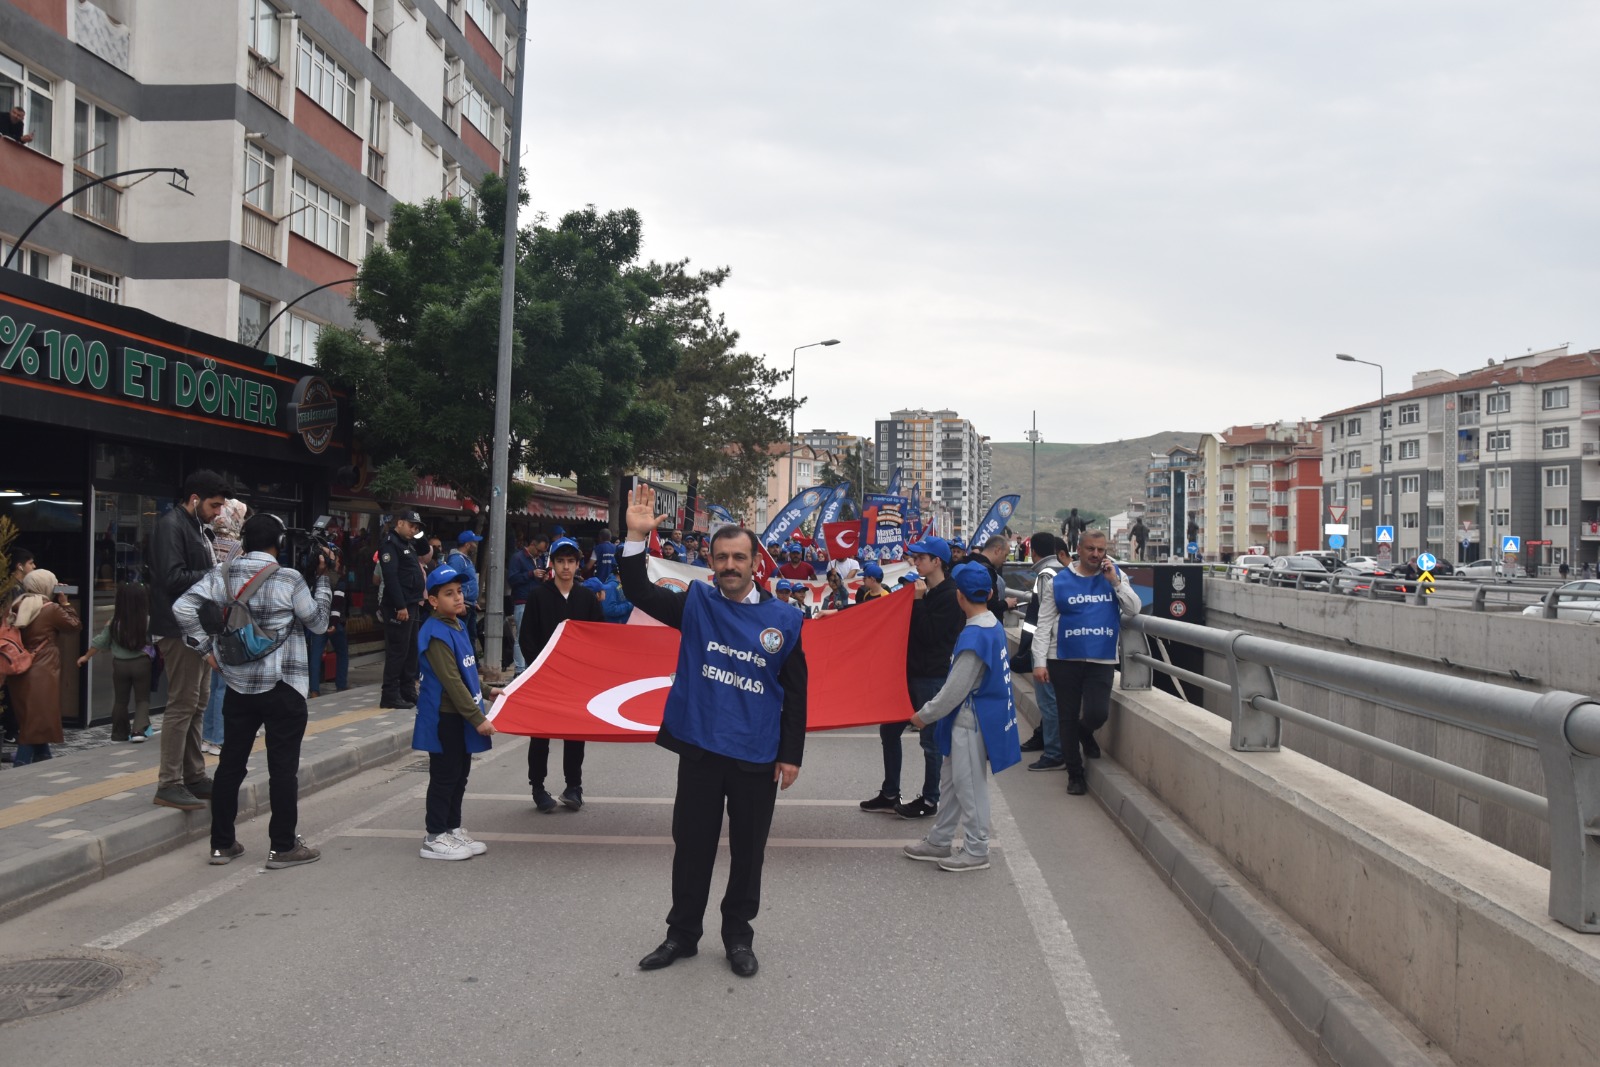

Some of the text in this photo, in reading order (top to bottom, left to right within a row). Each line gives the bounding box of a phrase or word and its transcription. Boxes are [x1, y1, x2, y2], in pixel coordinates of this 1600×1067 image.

[0, 316, 278, 426] %100 ET DÖNER
[656, 491, 676, 517] EYHAN
[818, 501, 840, 540] prol-iş
[863, 506, 878, 544] 1
[1068, 592, 1113, 605] GÖREVLİ
[1065, 627, 1114, 638] petrol-iş
[706, 641, 767, 668] petrol-iş
[702, 664, 765, 694] SENDİKASI
